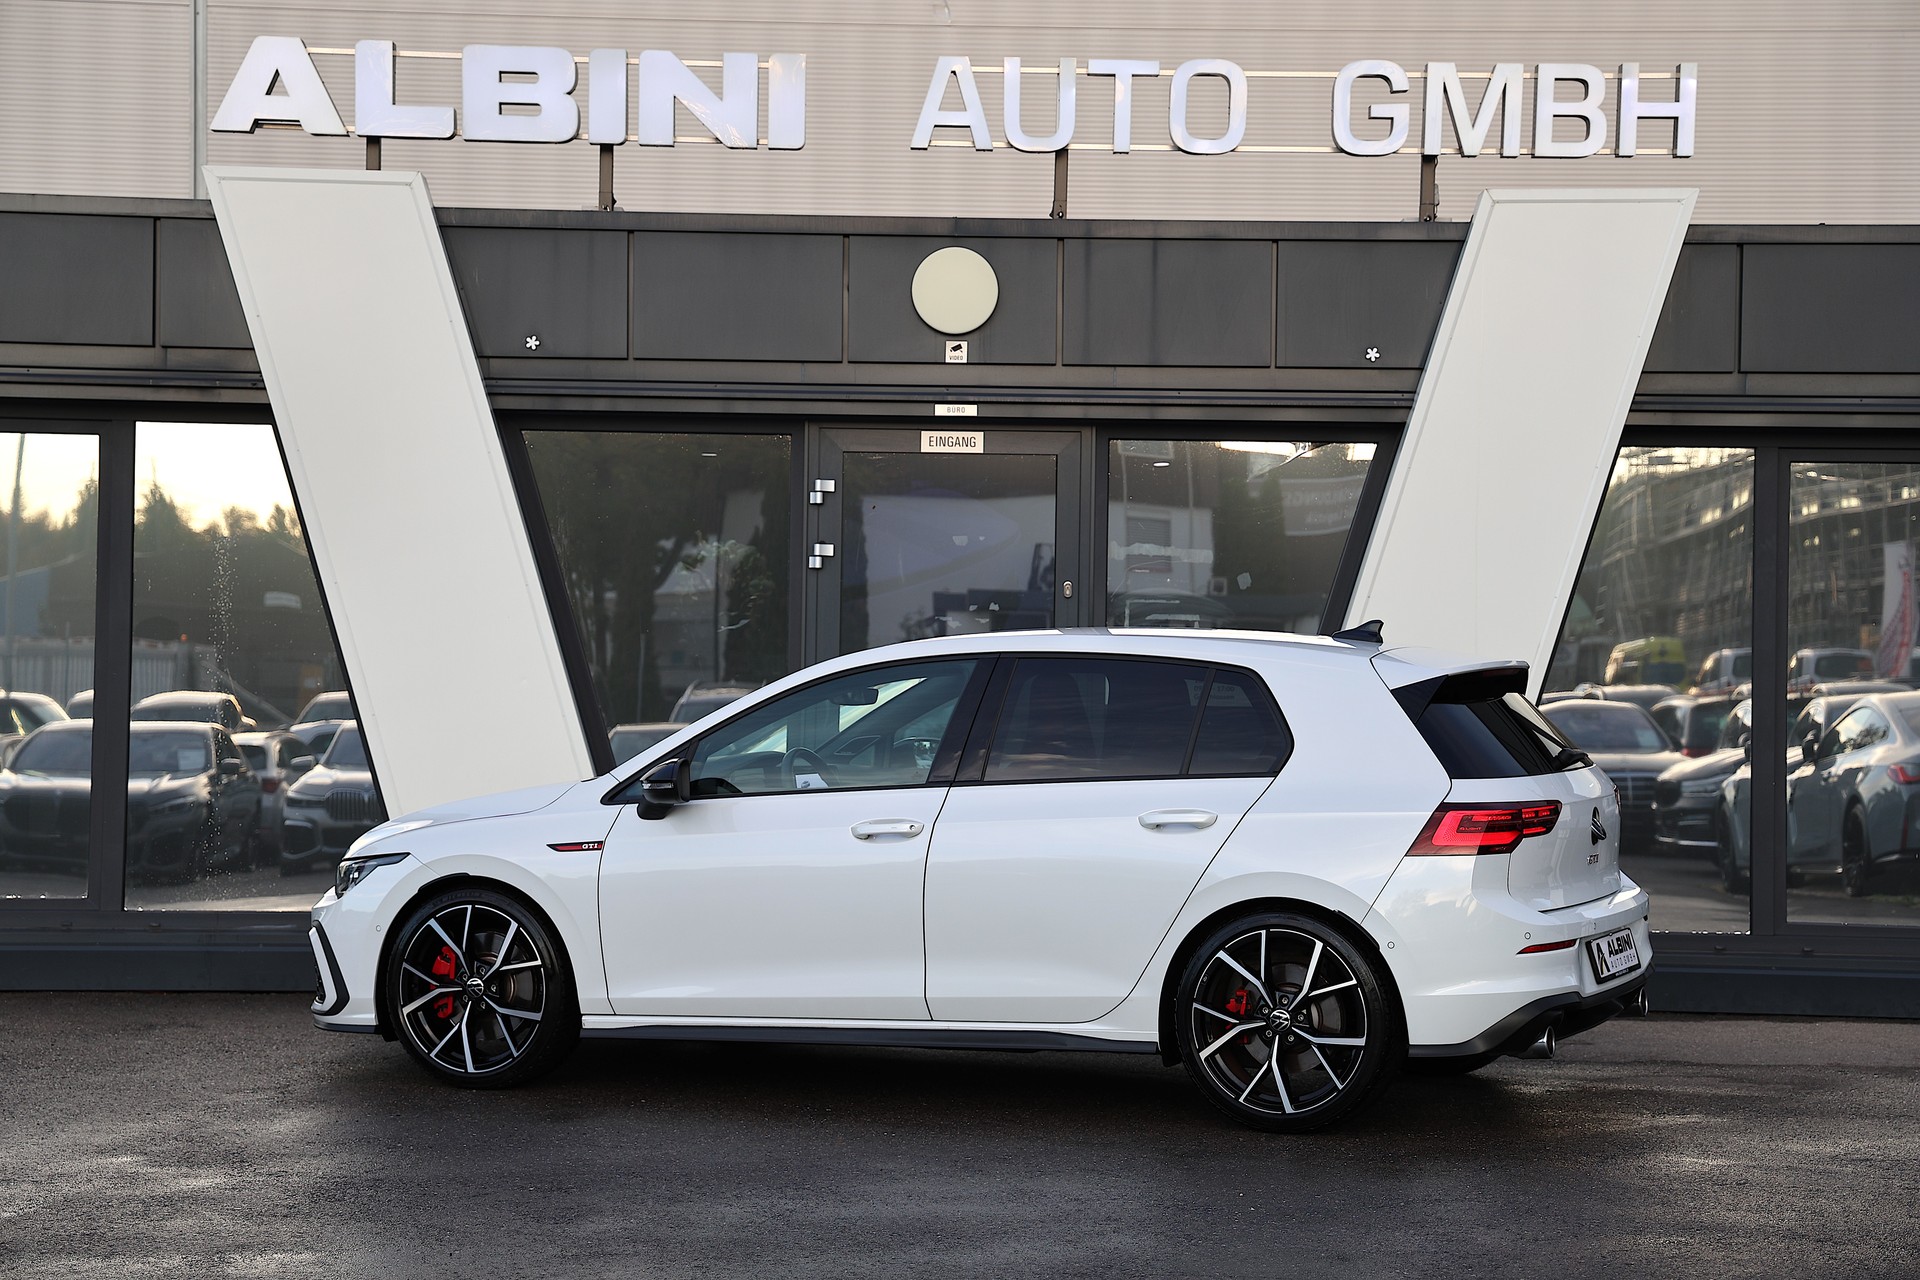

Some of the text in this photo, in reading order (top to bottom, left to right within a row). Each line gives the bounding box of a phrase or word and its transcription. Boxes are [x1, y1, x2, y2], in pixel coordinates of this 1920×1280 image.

[210, 35, 1699, 158] ALBINI AUTO GMBH
[928, 435, 977, 448] EINGANG
[1607, 934, 1633, 957] ALBINI
